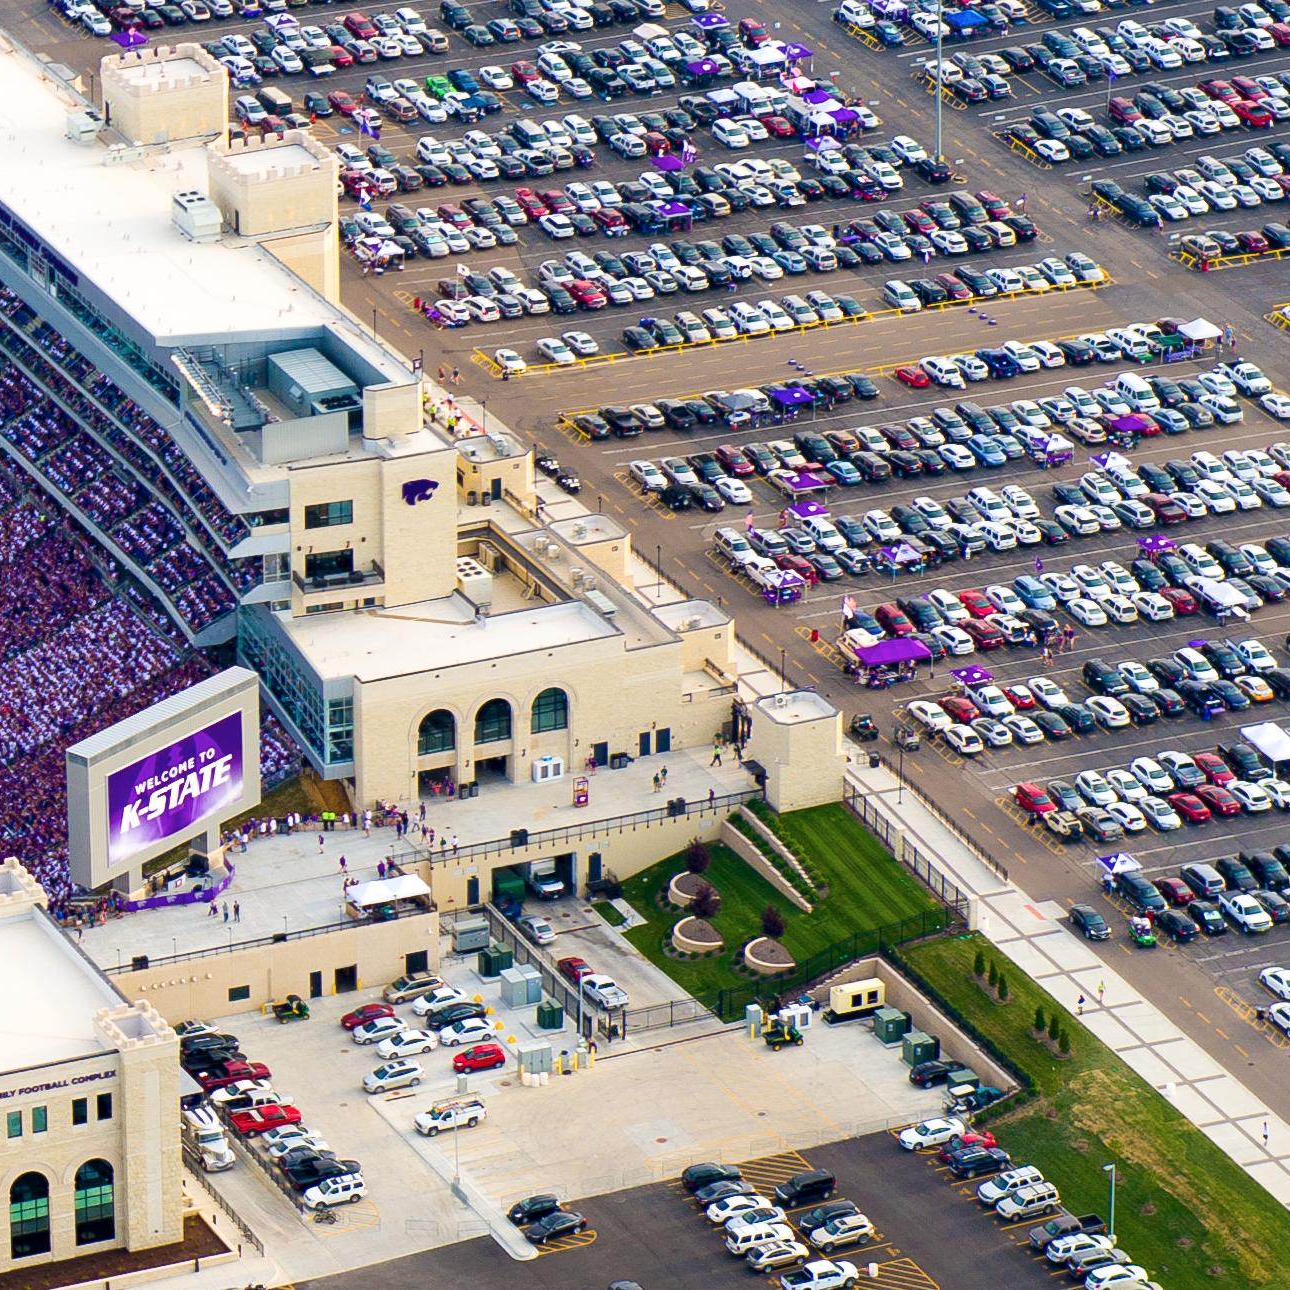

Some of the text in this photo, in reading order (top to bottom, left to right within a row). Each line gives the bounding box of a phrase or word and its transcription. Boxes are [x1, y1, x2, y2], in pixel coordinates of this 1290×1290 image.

[120, 753, 233, 834] K-STATE
[135, 747, 216, 796] WELCOME TO
[18, 1080, 69, 1095] FOOTBALL
[71, 1070, 117, 1085] COMPLEX
